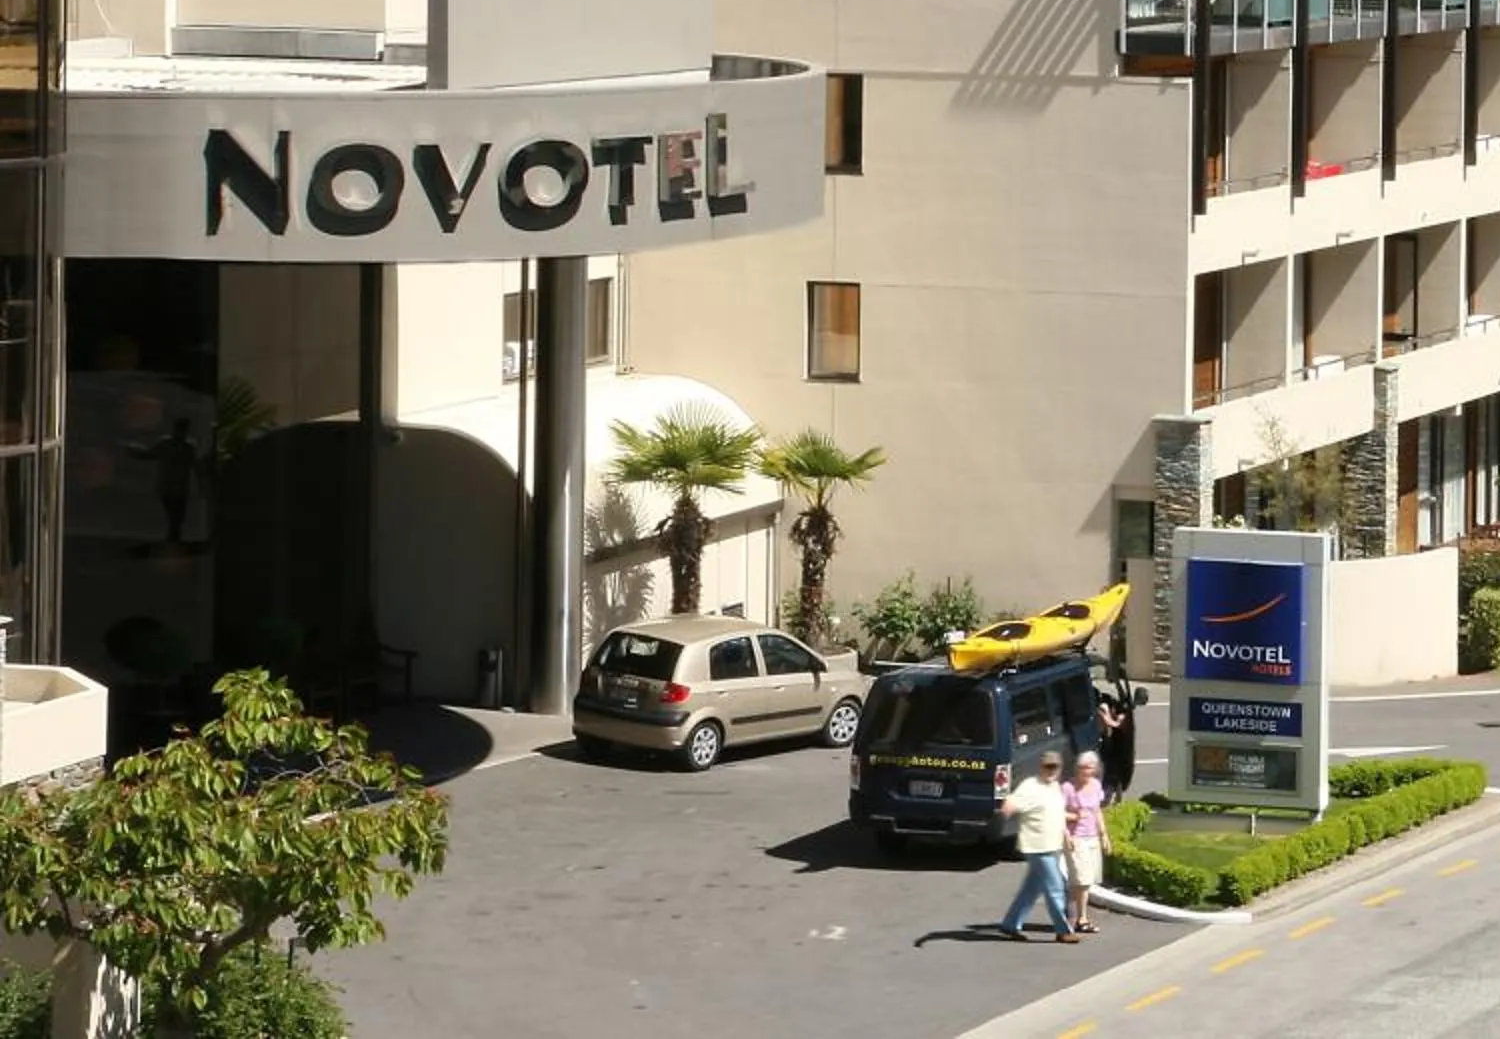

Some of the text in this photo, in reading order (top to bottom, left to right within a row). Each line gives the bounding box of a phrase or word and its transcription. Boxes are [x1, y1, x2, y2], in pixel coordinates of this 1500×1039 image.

[203, 112, 756, 238] NOVOTEL
[1193, 640, 1291, 664] NOVOTEL
[1201, 702, 1291, 718] QUEENSTOWN
[1215, 717, 1277, 732] LAKESIDE
